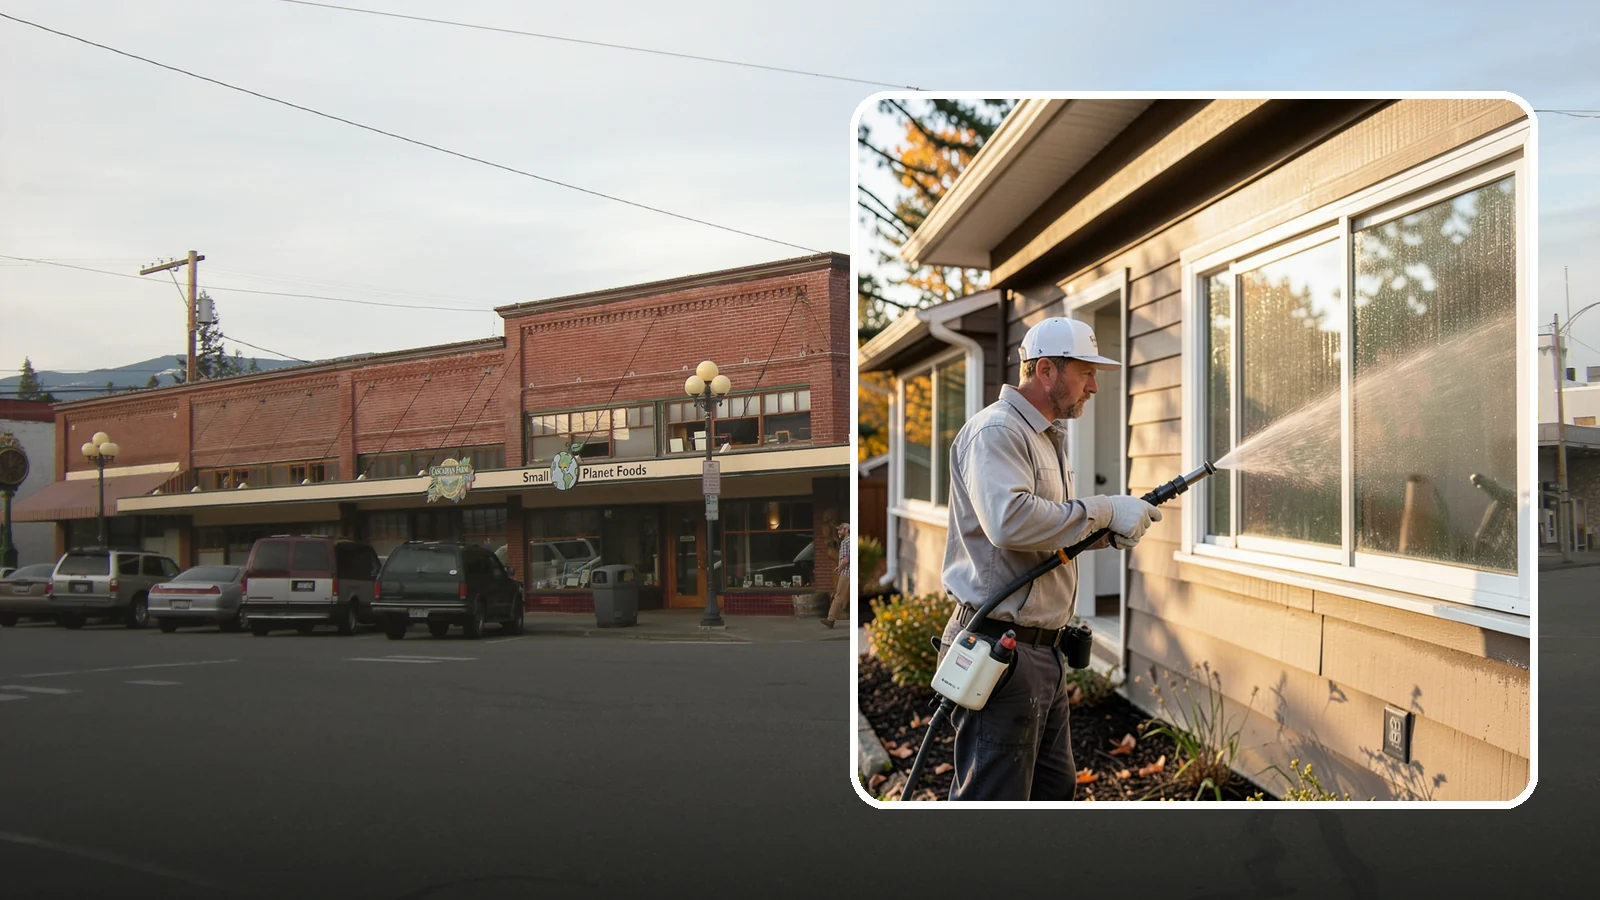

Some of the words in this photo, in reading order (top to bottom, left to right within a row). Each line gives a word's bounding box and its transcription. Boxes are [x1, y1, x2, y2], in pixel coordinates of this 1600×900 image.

[523, 470, 549, 483] Small
[583, 467, 614, 479] Planet
[617, 464, 647, 477] Foods
